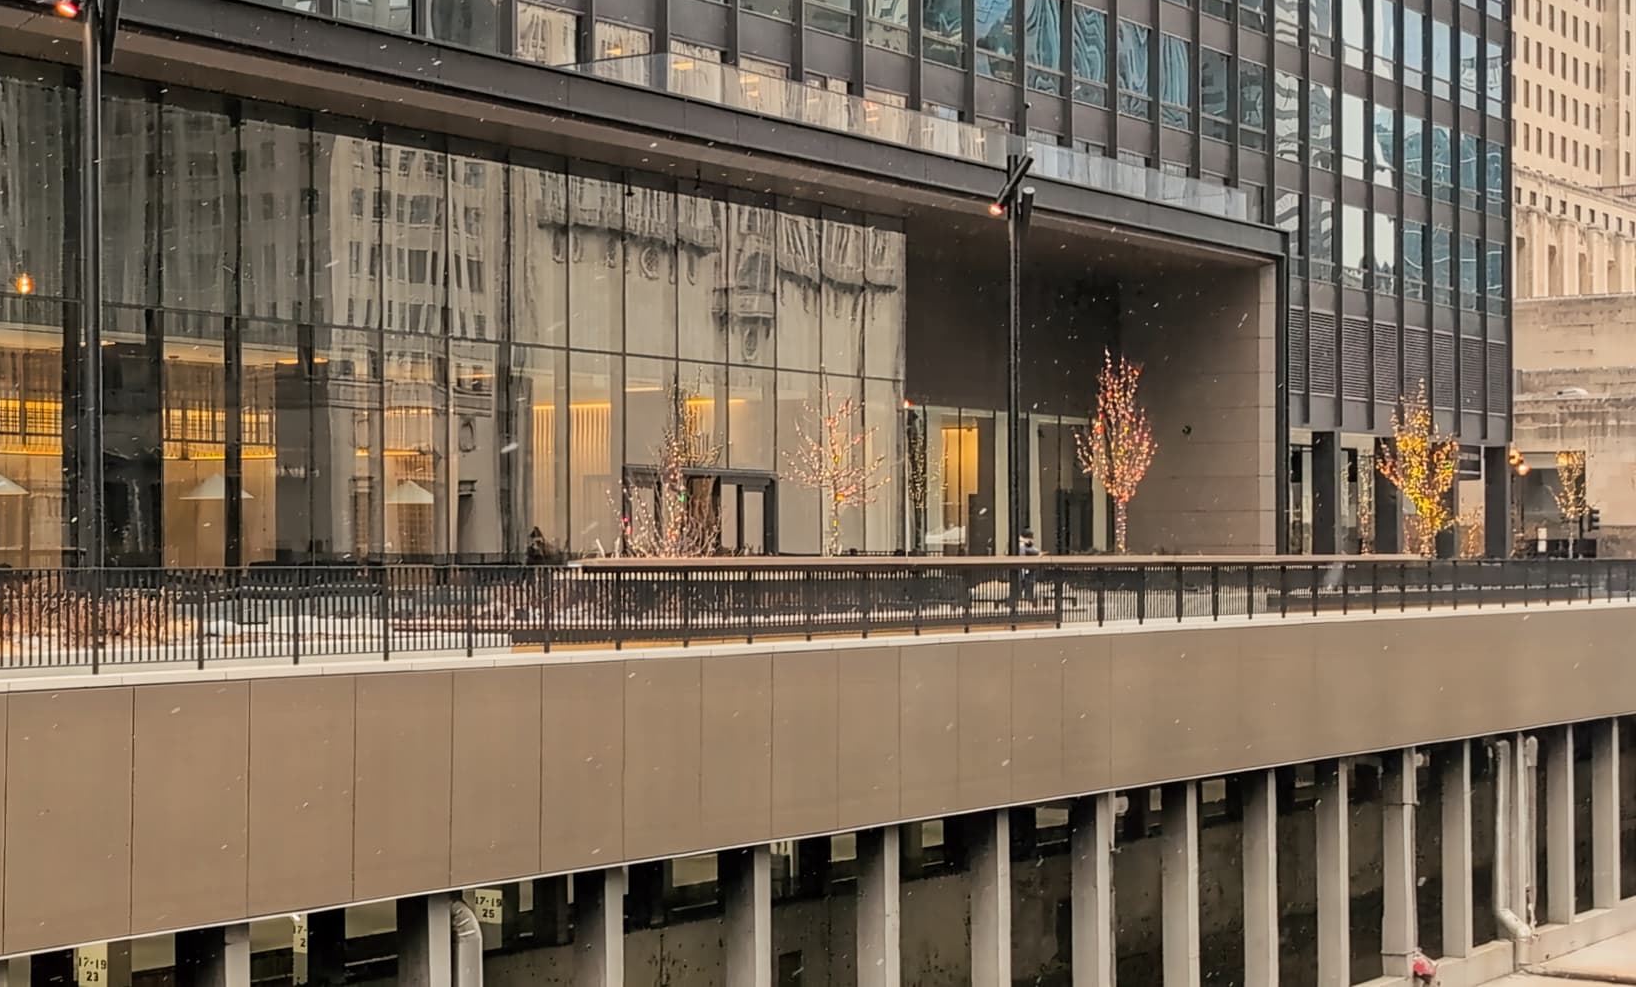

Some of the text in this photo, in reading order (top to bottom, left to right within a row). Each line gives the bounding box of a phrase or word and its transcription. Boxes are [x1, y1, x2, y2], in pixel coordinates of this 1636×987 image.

[475, 896, 502, 907] 17-19
[482, 908, 495, 918] 25
[78, 956, 107, 970] 17-19
[86, 971, 99, 982] 23
